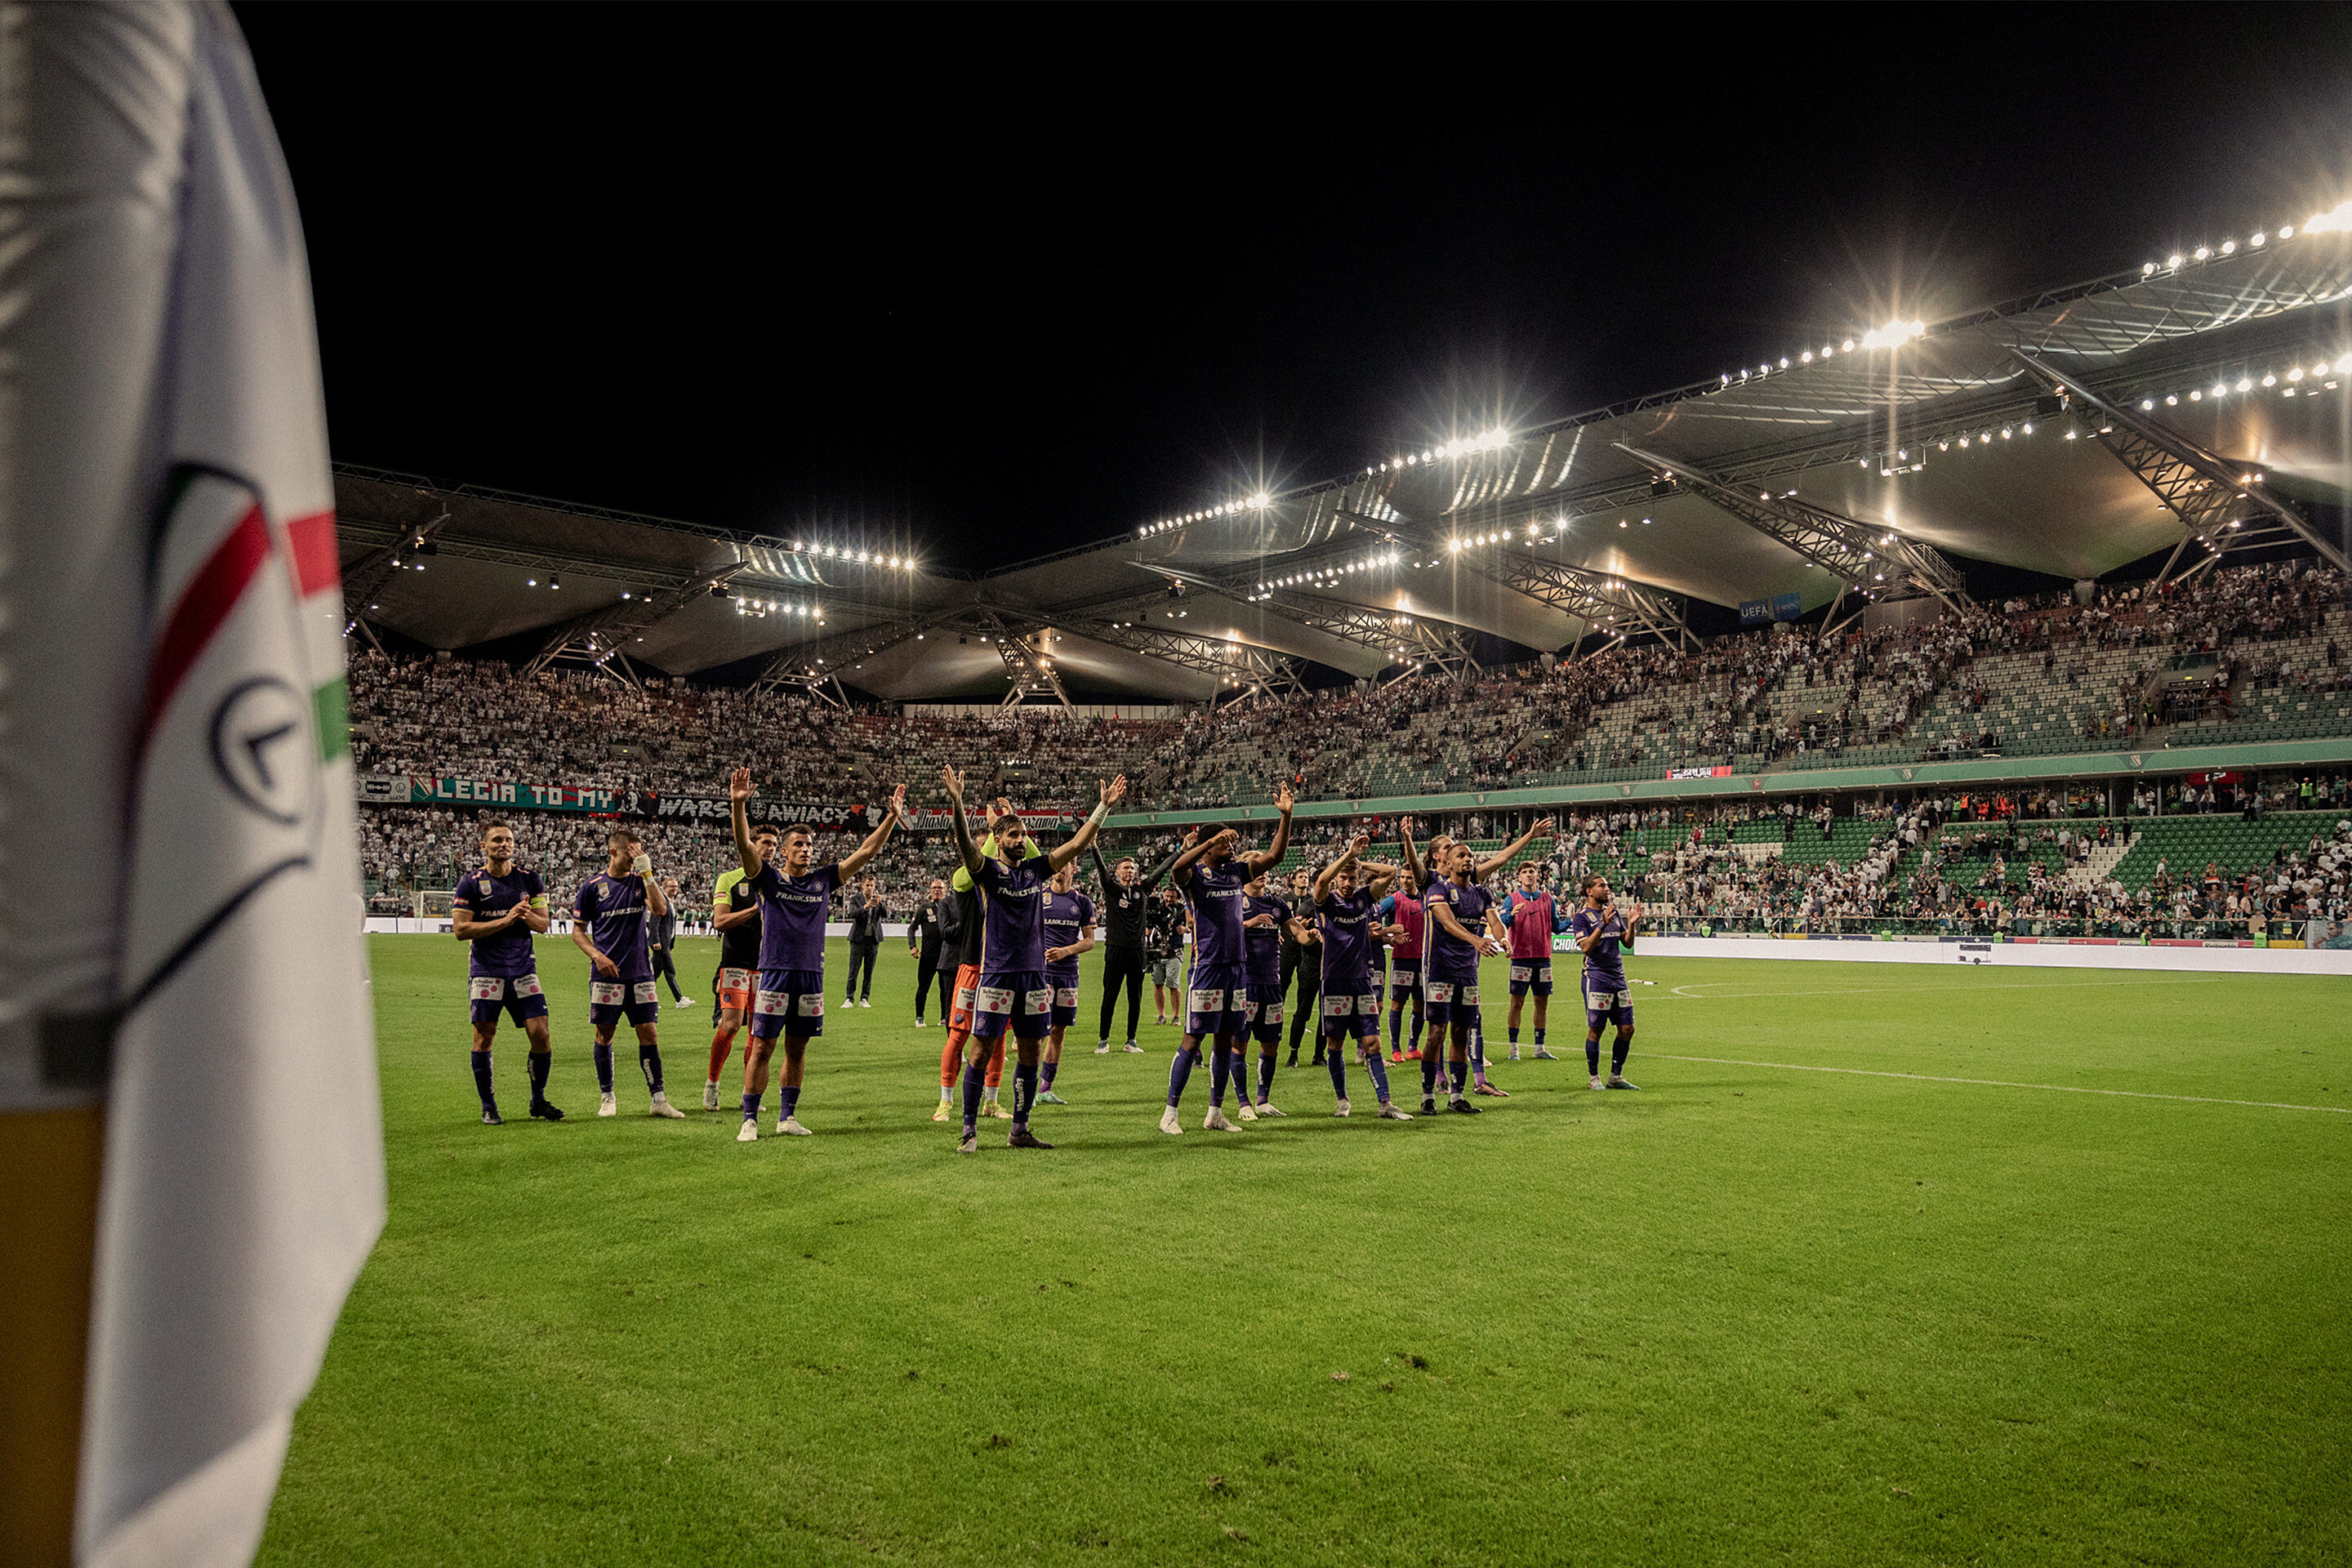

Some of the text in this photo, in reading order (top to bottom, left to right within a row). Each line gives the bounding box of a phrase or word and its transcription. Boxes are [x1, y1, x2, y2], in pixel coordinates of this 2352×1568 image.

[1741, 606, 1768, 617] UEFA
[436, 779, 612, 808] LEGIA TO MY
[1552, 938, 1583, 951] CHOD
